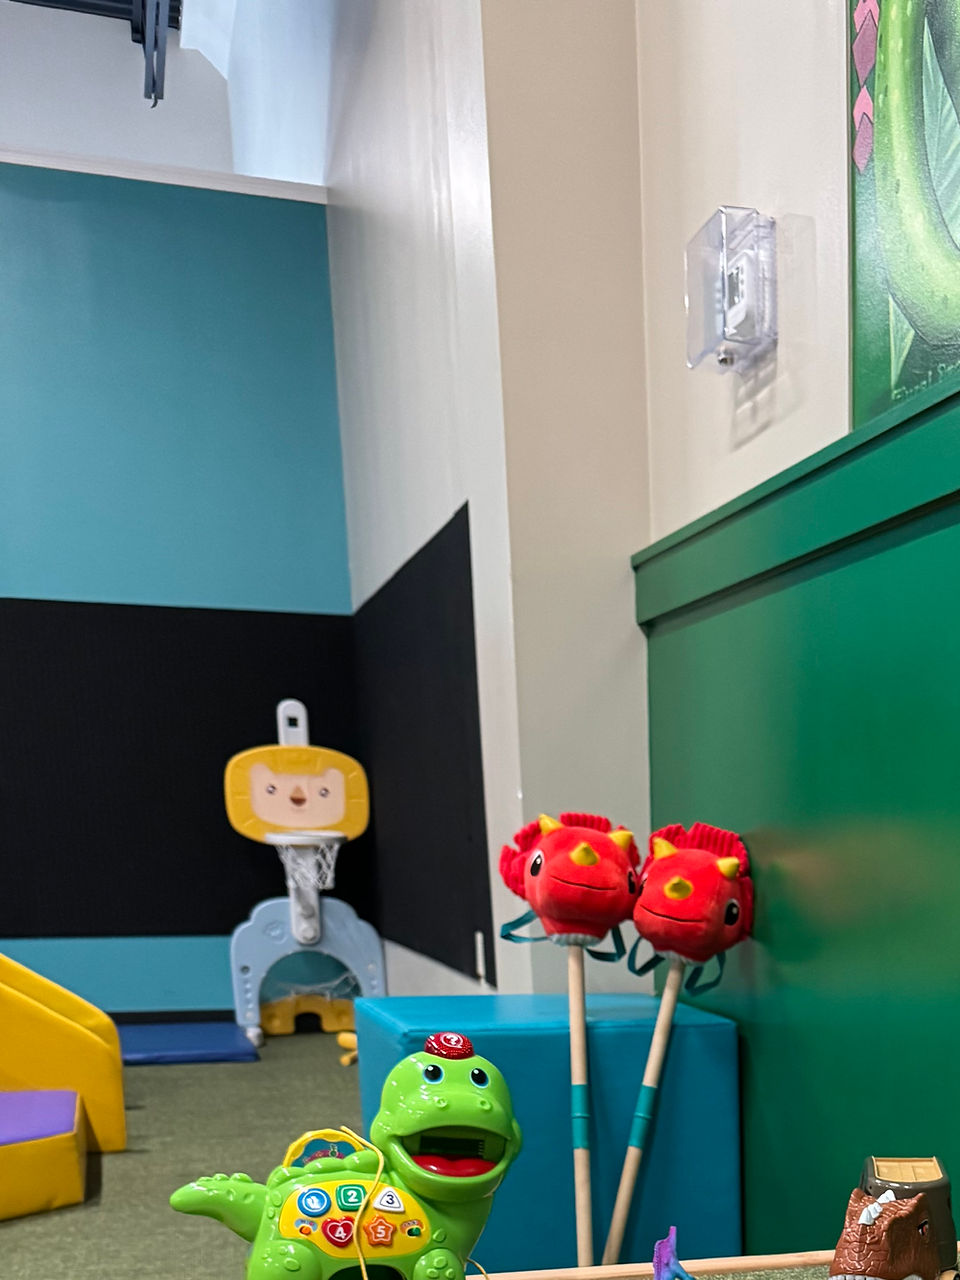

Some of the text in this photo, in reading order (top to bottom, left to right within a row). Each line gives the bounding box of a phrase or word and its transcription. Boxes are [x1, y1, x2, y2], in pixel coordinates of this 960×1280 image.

[346, 1190, 358, 1202] 2
[386, 1194, 394, 1205] 3
[335, 1227, 346, 1239] 4
[376, 1226, 385, 1238] 5
